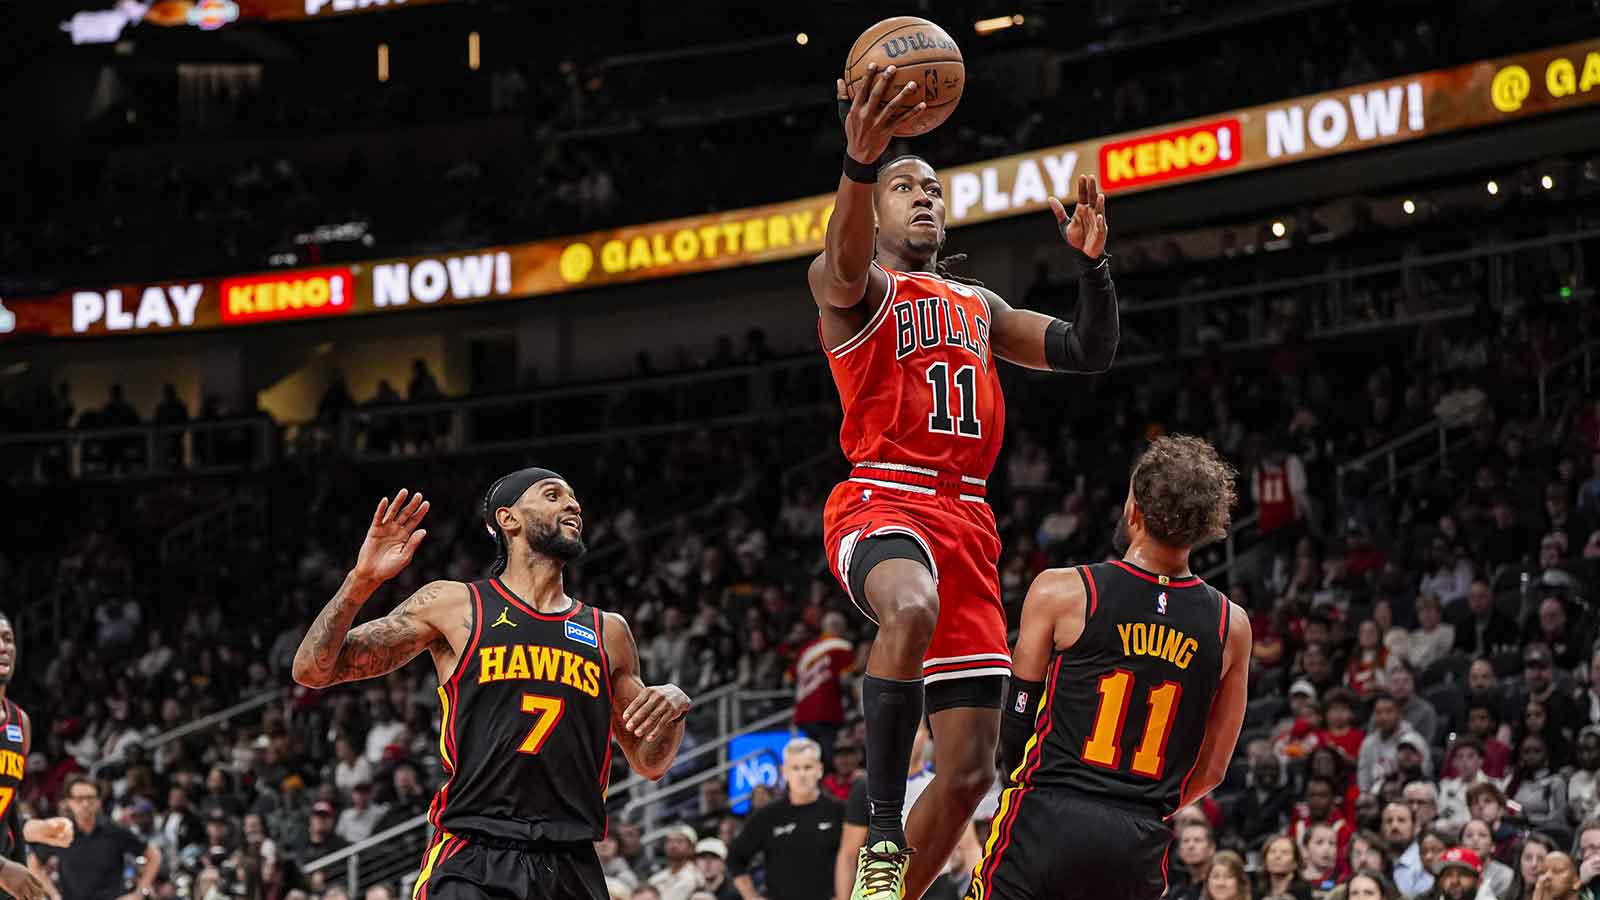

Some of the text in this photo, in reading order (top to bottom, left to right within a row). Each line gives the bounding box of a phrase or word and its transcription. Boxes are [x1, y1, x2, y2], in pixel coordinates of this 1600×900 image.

[882, 32, 958, 58] Wilson
[1491, 52, 1600, 112] @ GA
[951, 82, 1425, 219] PLAY KENO! NOW!
[72, 283, 203, 333] PLAY
[228, 274, 345, 315] KENO!
[373, 251, 512, 308] NOW!
[560, 242, 593, 284] @
[893, 297, 990, 375] BULLS
[926, 360, 982, 439] 11
[478, 644, 600, 698] HAWKS
[1116, 623, 1200, 671] YOUNG
[516, 693, 565, 755] 7
[1081, 668, 1183, 783] 11
